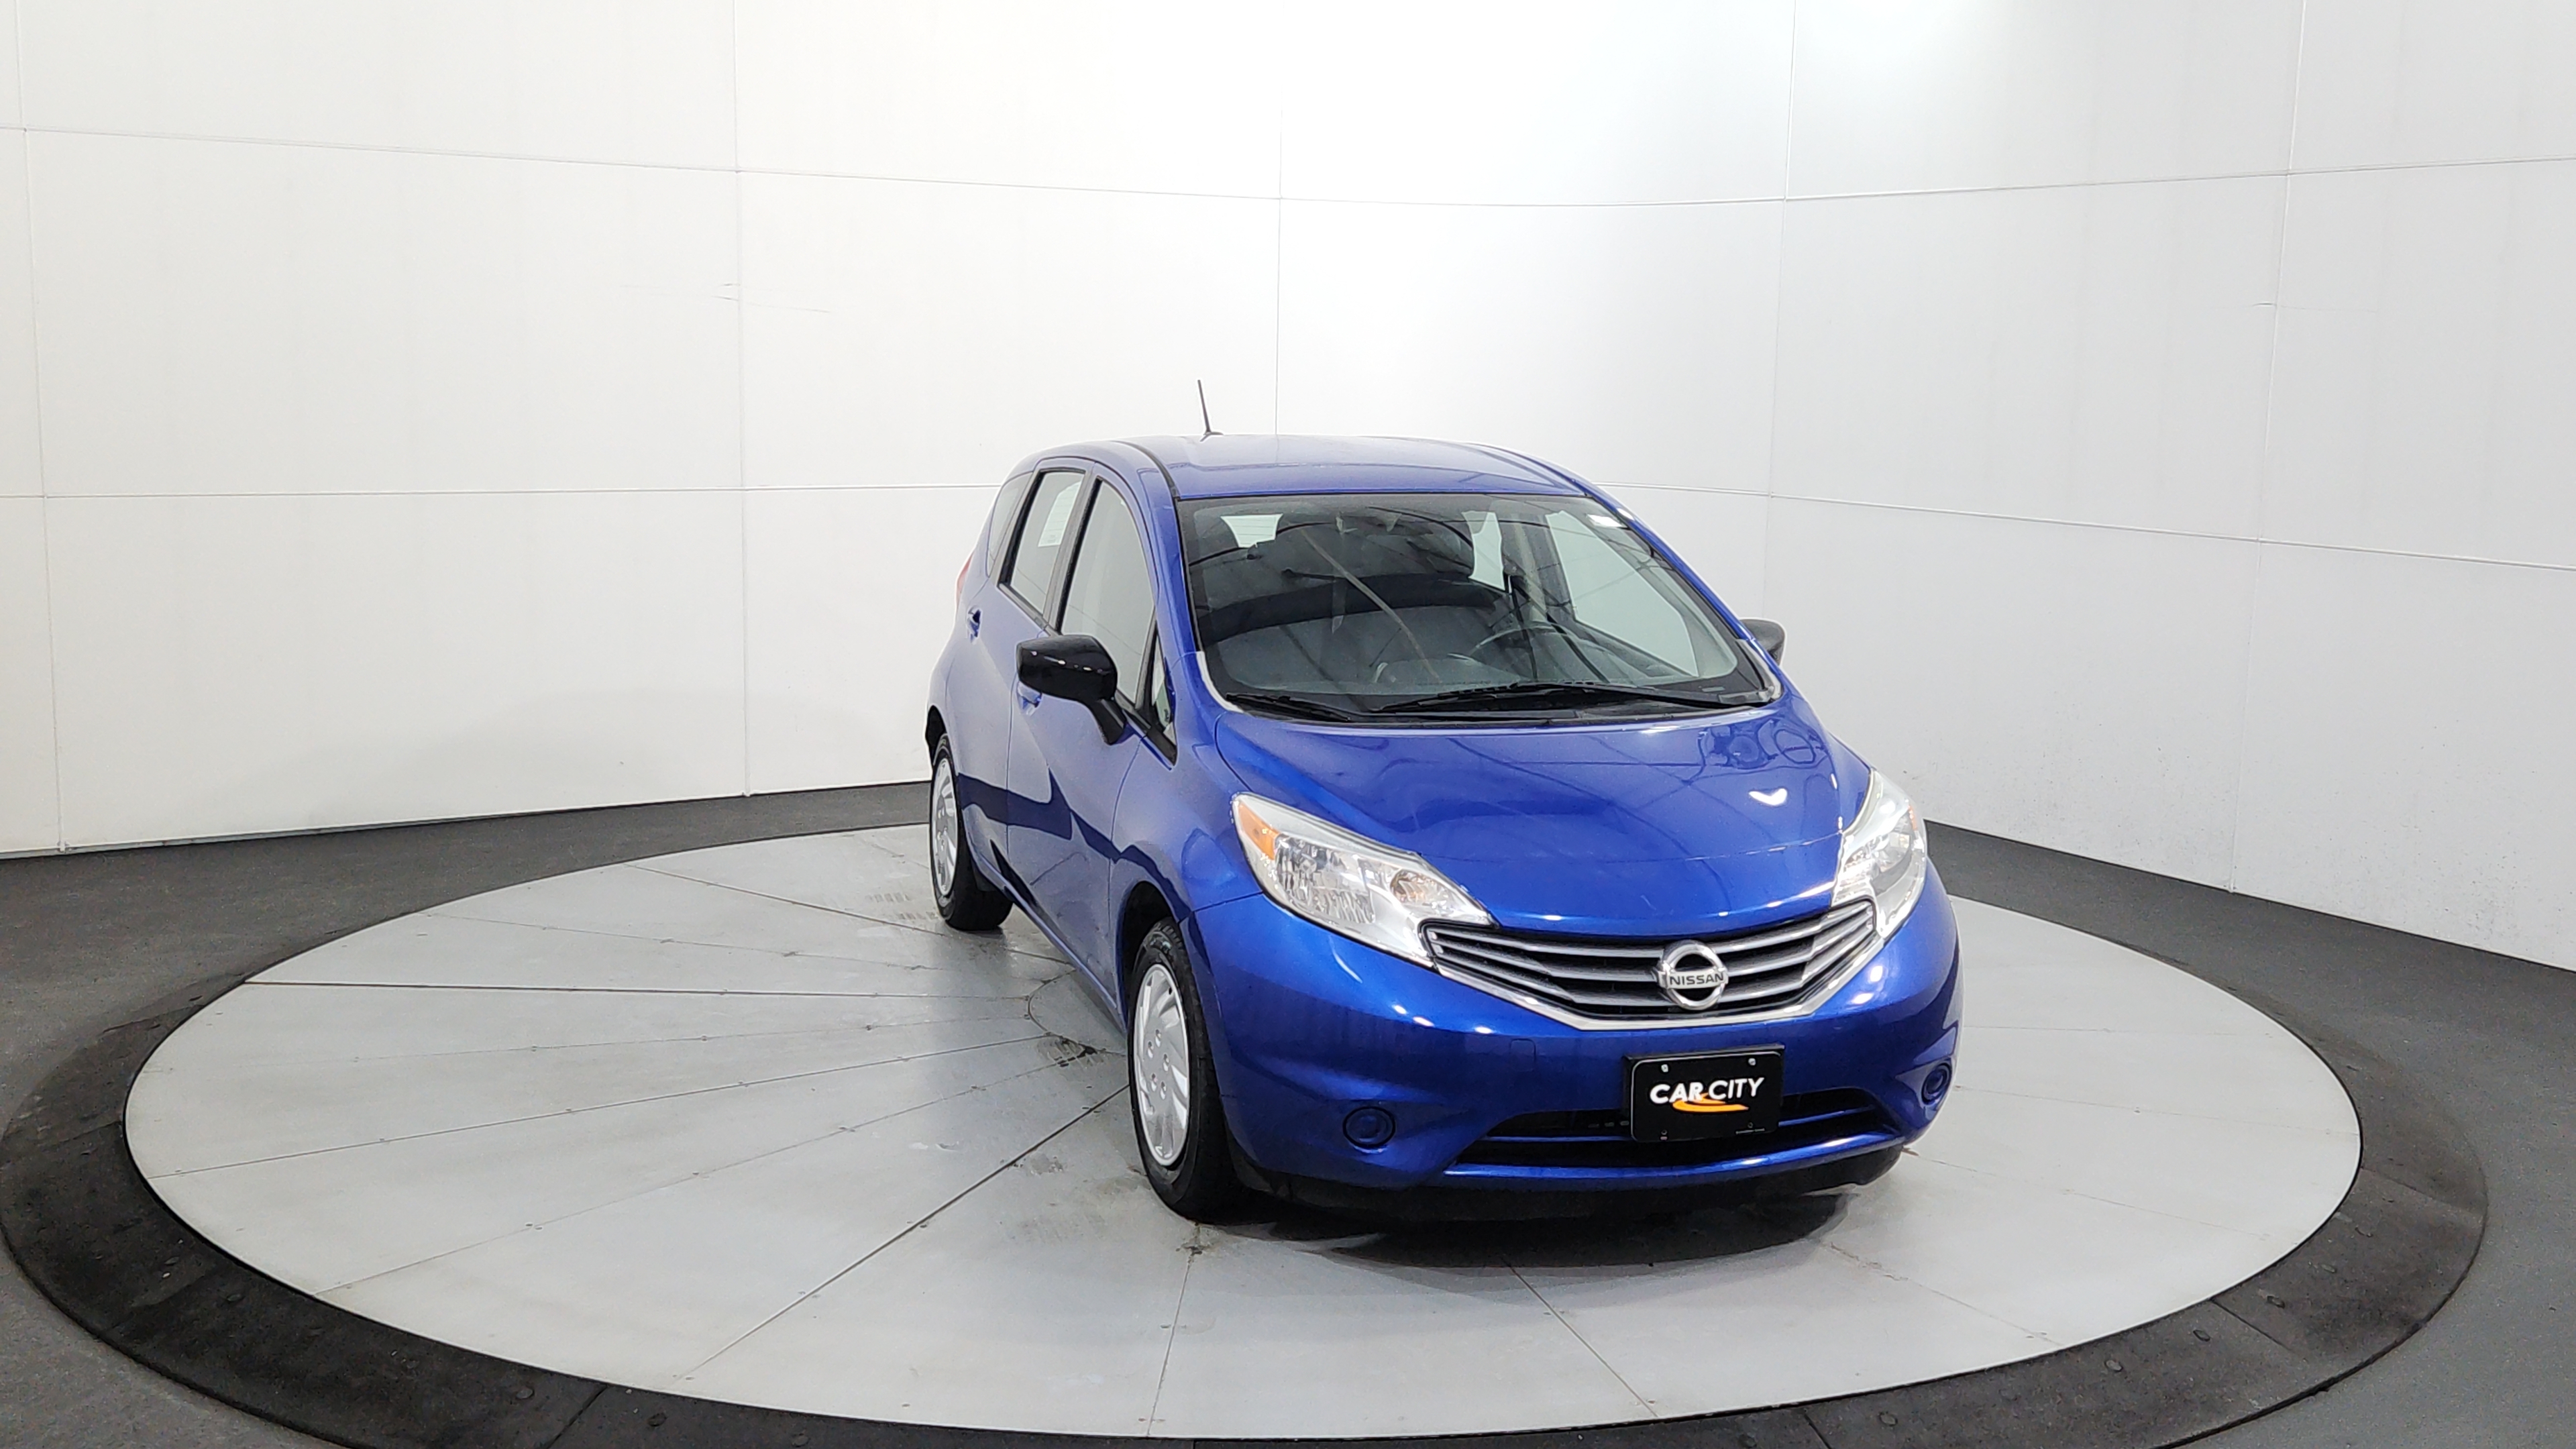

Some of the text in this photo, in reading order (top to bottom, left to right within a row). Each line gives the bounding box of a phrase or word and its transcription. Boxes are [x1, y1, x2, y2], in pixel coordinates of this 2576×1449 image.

[1670, 973, 1723, 985] NISSAN
[1650, 1077, 1764, 1104] CAR CITY
